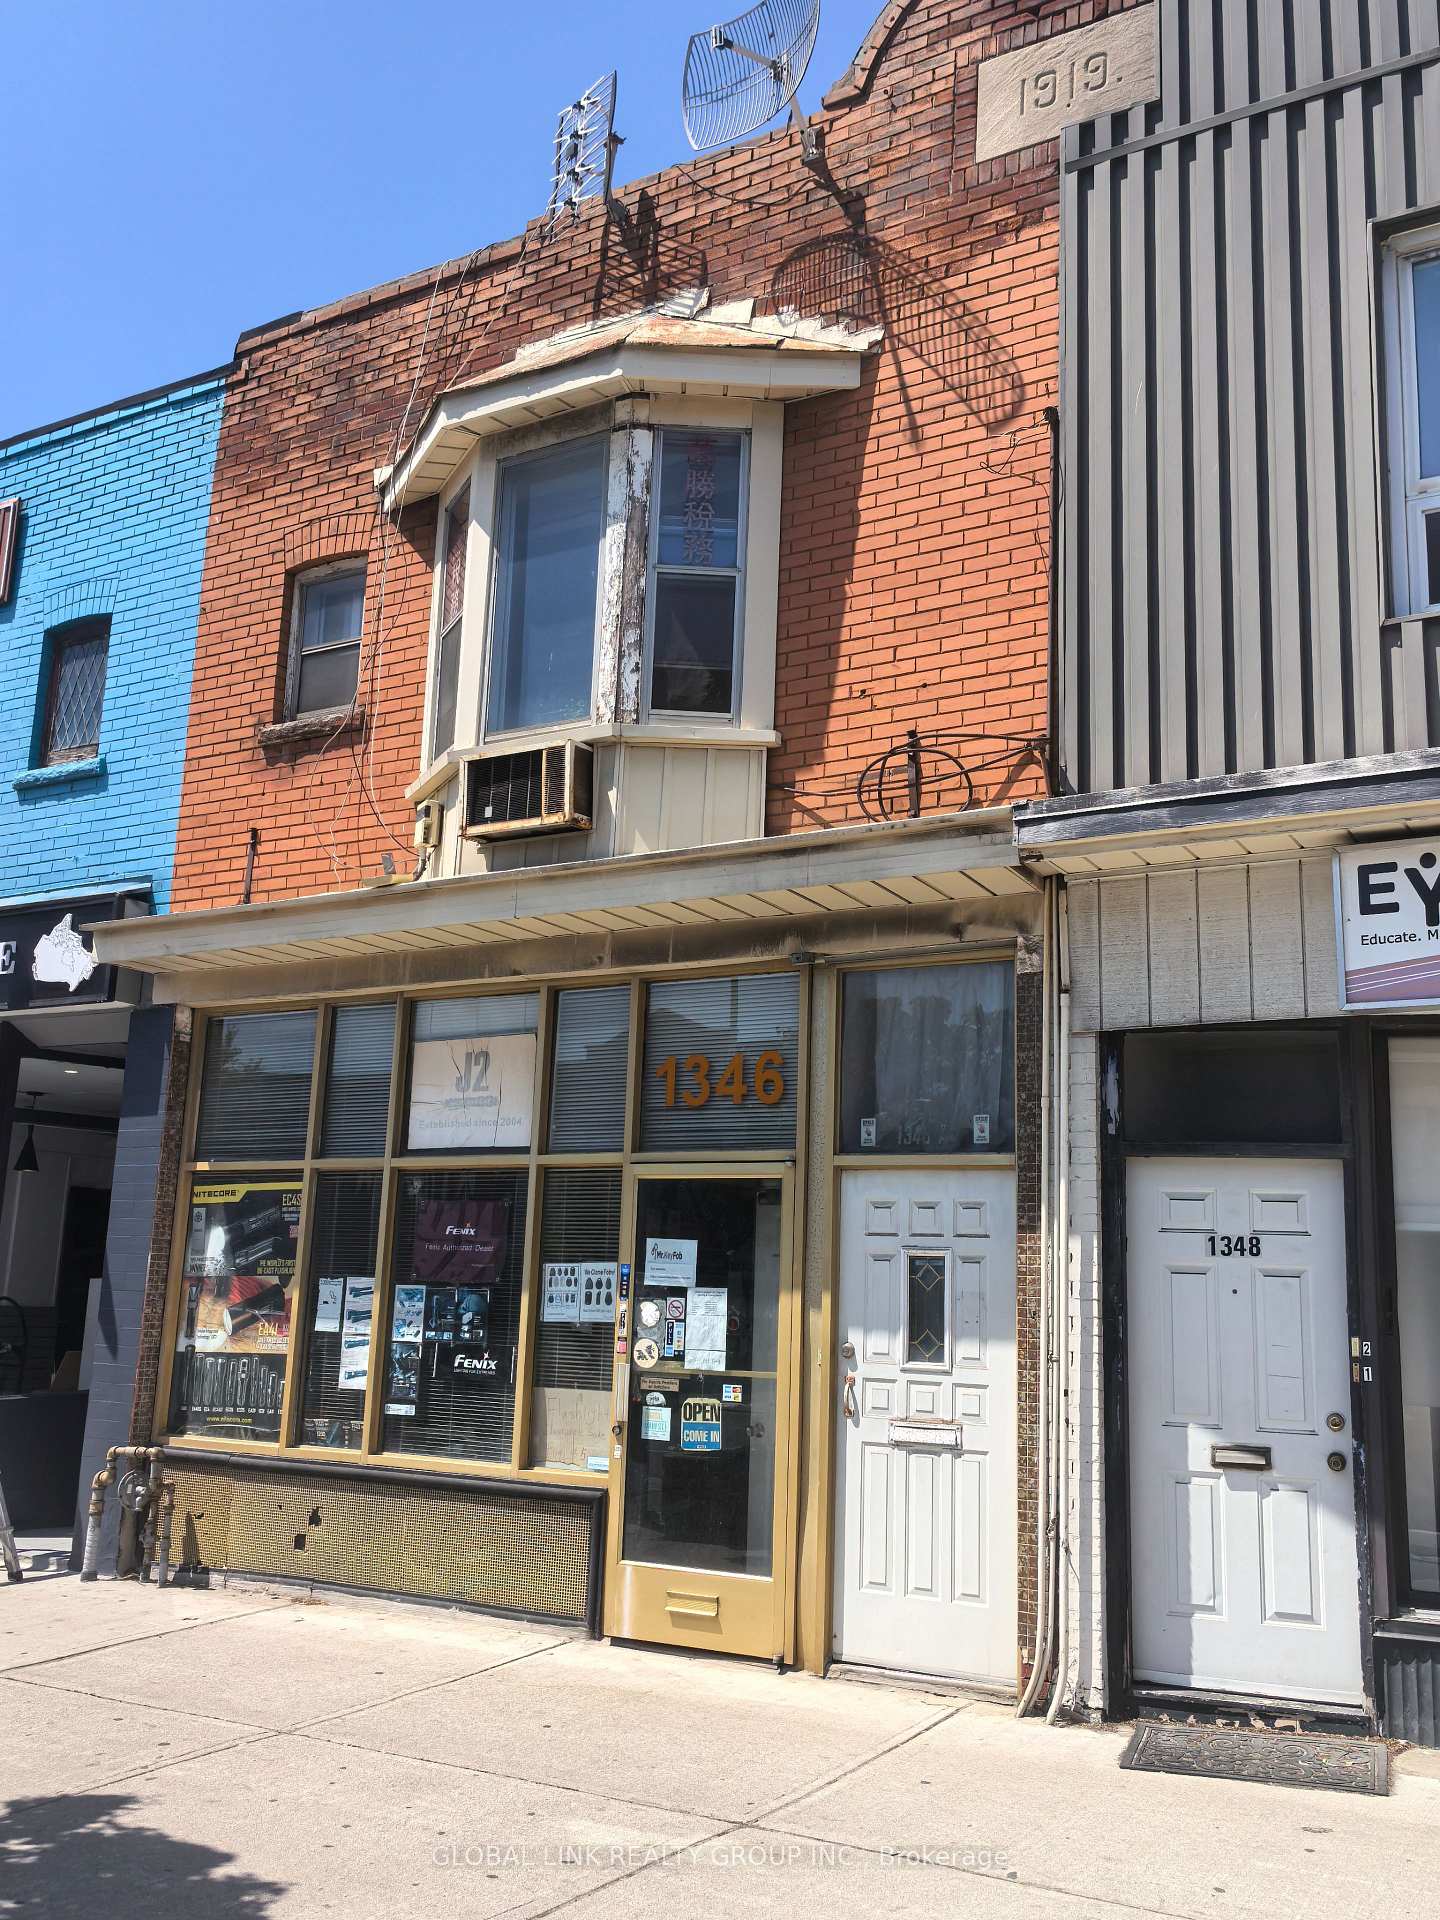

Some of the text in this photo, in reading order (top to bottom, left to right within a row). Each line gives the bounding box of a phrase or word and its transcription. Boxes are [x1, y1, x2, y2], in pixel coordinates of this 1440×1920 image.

[1360, 931, 1422, 946] Educate.
[456, 1050, 490, 1092] J2
[656, 1050, 785, 1108] 1346
[418, 1118, 472, 1129] Established
[192, 1189, 238, 1198] NITECORE
[1207, 1235, 1261, 1257] 1348
[1363, 1343, 1370, 1355] 2
[1365, 1368, 1371, 1380] 1
[682, 1402, 720, 1422] OPEN
[683, 1429, 720, 1442] COME IN
